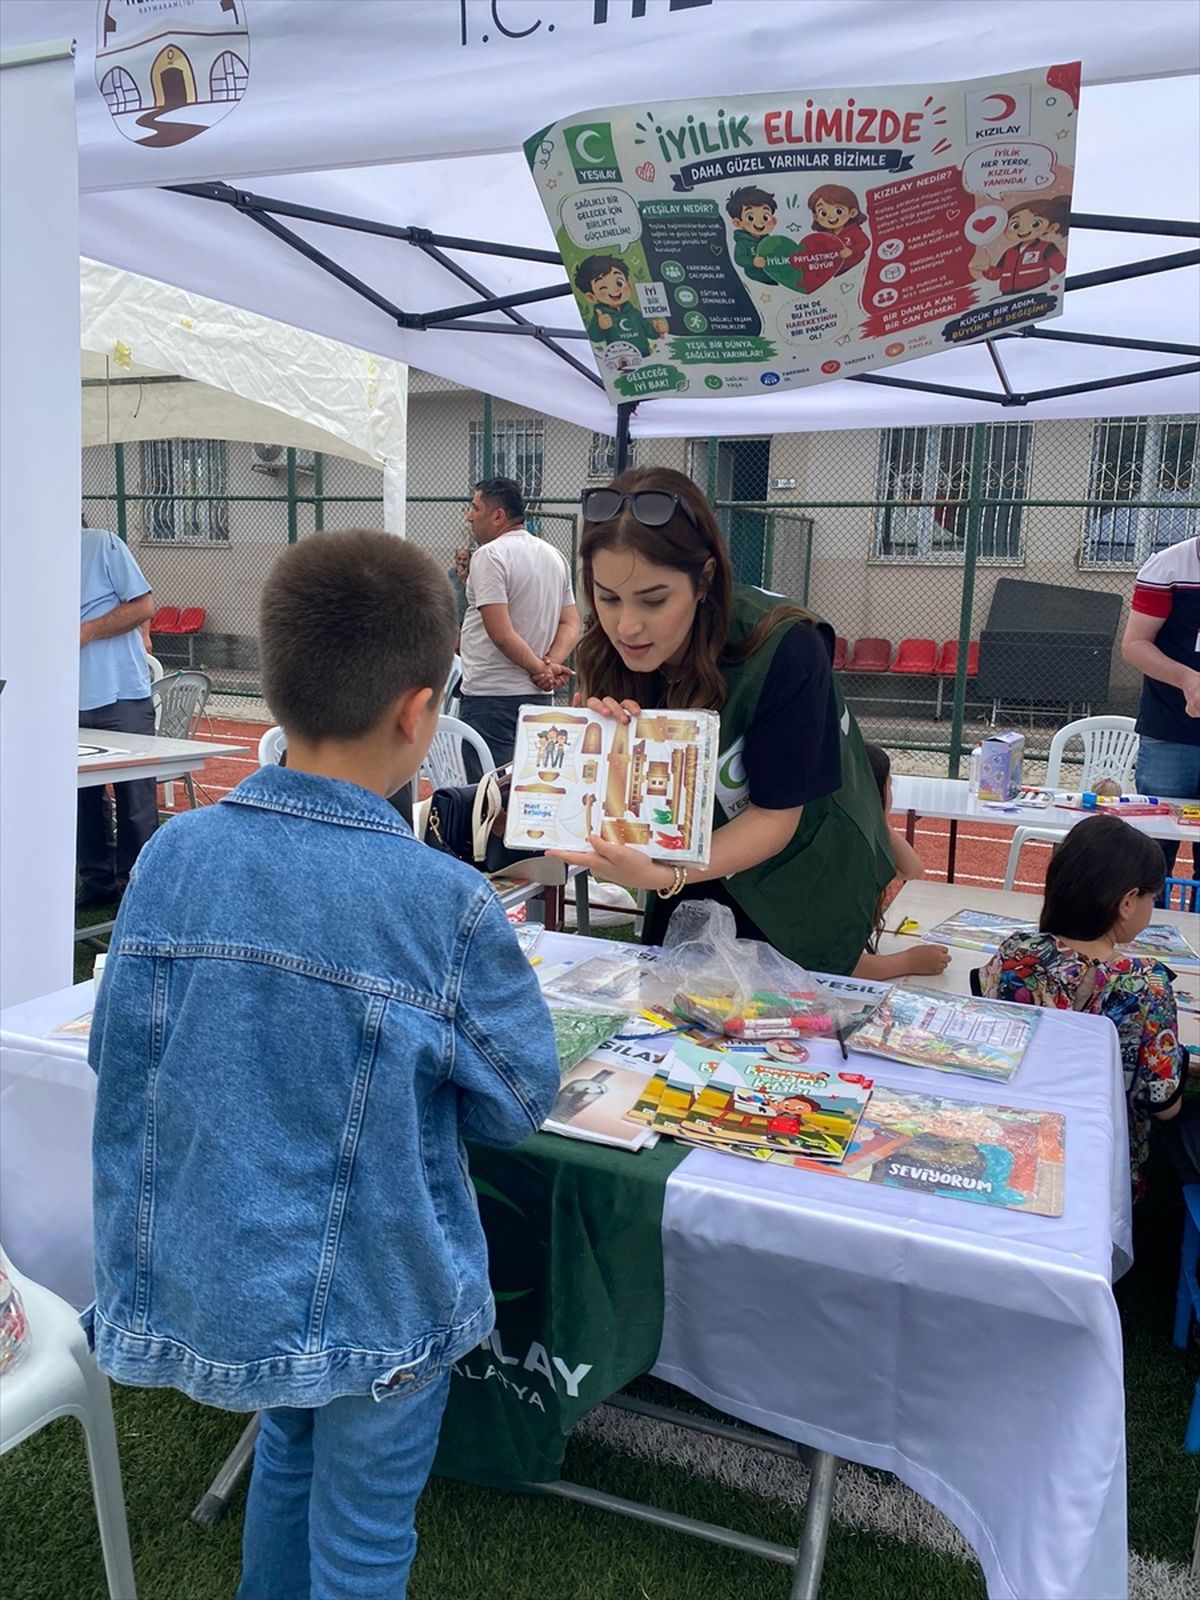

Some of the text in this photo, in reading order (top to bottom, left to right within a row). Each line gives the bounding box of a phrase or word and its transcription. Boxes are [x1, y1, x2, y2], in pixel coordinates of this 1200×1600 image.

[656, 98, 924, 163] İYİLİK ELİMİZDE
[975, 125, 1021, 138] KIZILAY
[994, 147, 1021, 157] İYİLİK
[691, 151, 886, 180] DAHA GÜZEL YARINLAR BİZİMLE
[981, 159, 999, 168] HER
[987, 168, 1024, 177] KIZILAY
[873, 170, 952, 200] KIZILAY NEDİR?
[984, 177, 1027, 187] YANINDA!
[606, 194, 619, 204] BİR
[577, 206, 623, 221] GELECEK İÇİN
[645, 202, 714, 215] YEŞİLAY NEDİR?
[585, 217, 617, 230] BİRLİKTE
[584, 226, 631, 241] GÜÇLENELİM!
[766, 256, 791, 266] İYİLİK
[808, 261, 834, 271] BÜYÜR
[644, 285, 657, 296] İYİ
[794, 300, 821, 311] SEN DE
[882, 311, 898, 323] BİR
[900, 301, 932, 317] DAMLA
[804, 307, 828, 318] İYİLİK
[959, 310, 991, 328] KÜÇÜK
[785, 312, 838, 329] HAREKETİNİN
[884, 320, 900, 331] BİR
[902, 314, 921, 325] CAN
[790, 321, 837, 337] BİR PARÇASI
[952, 323, 984, 339] BÜYÜK
[986, 316, 1003, 328] BİR
[685, 340, 708, 350] YEŞİL
[709, 338, 723, 349] BİR
[723, 349, 764, 359] YARINLAR!
[626, 366, 669, 382] GELECEĞE
[633, 379, 670, 392] İYİ BAK!
